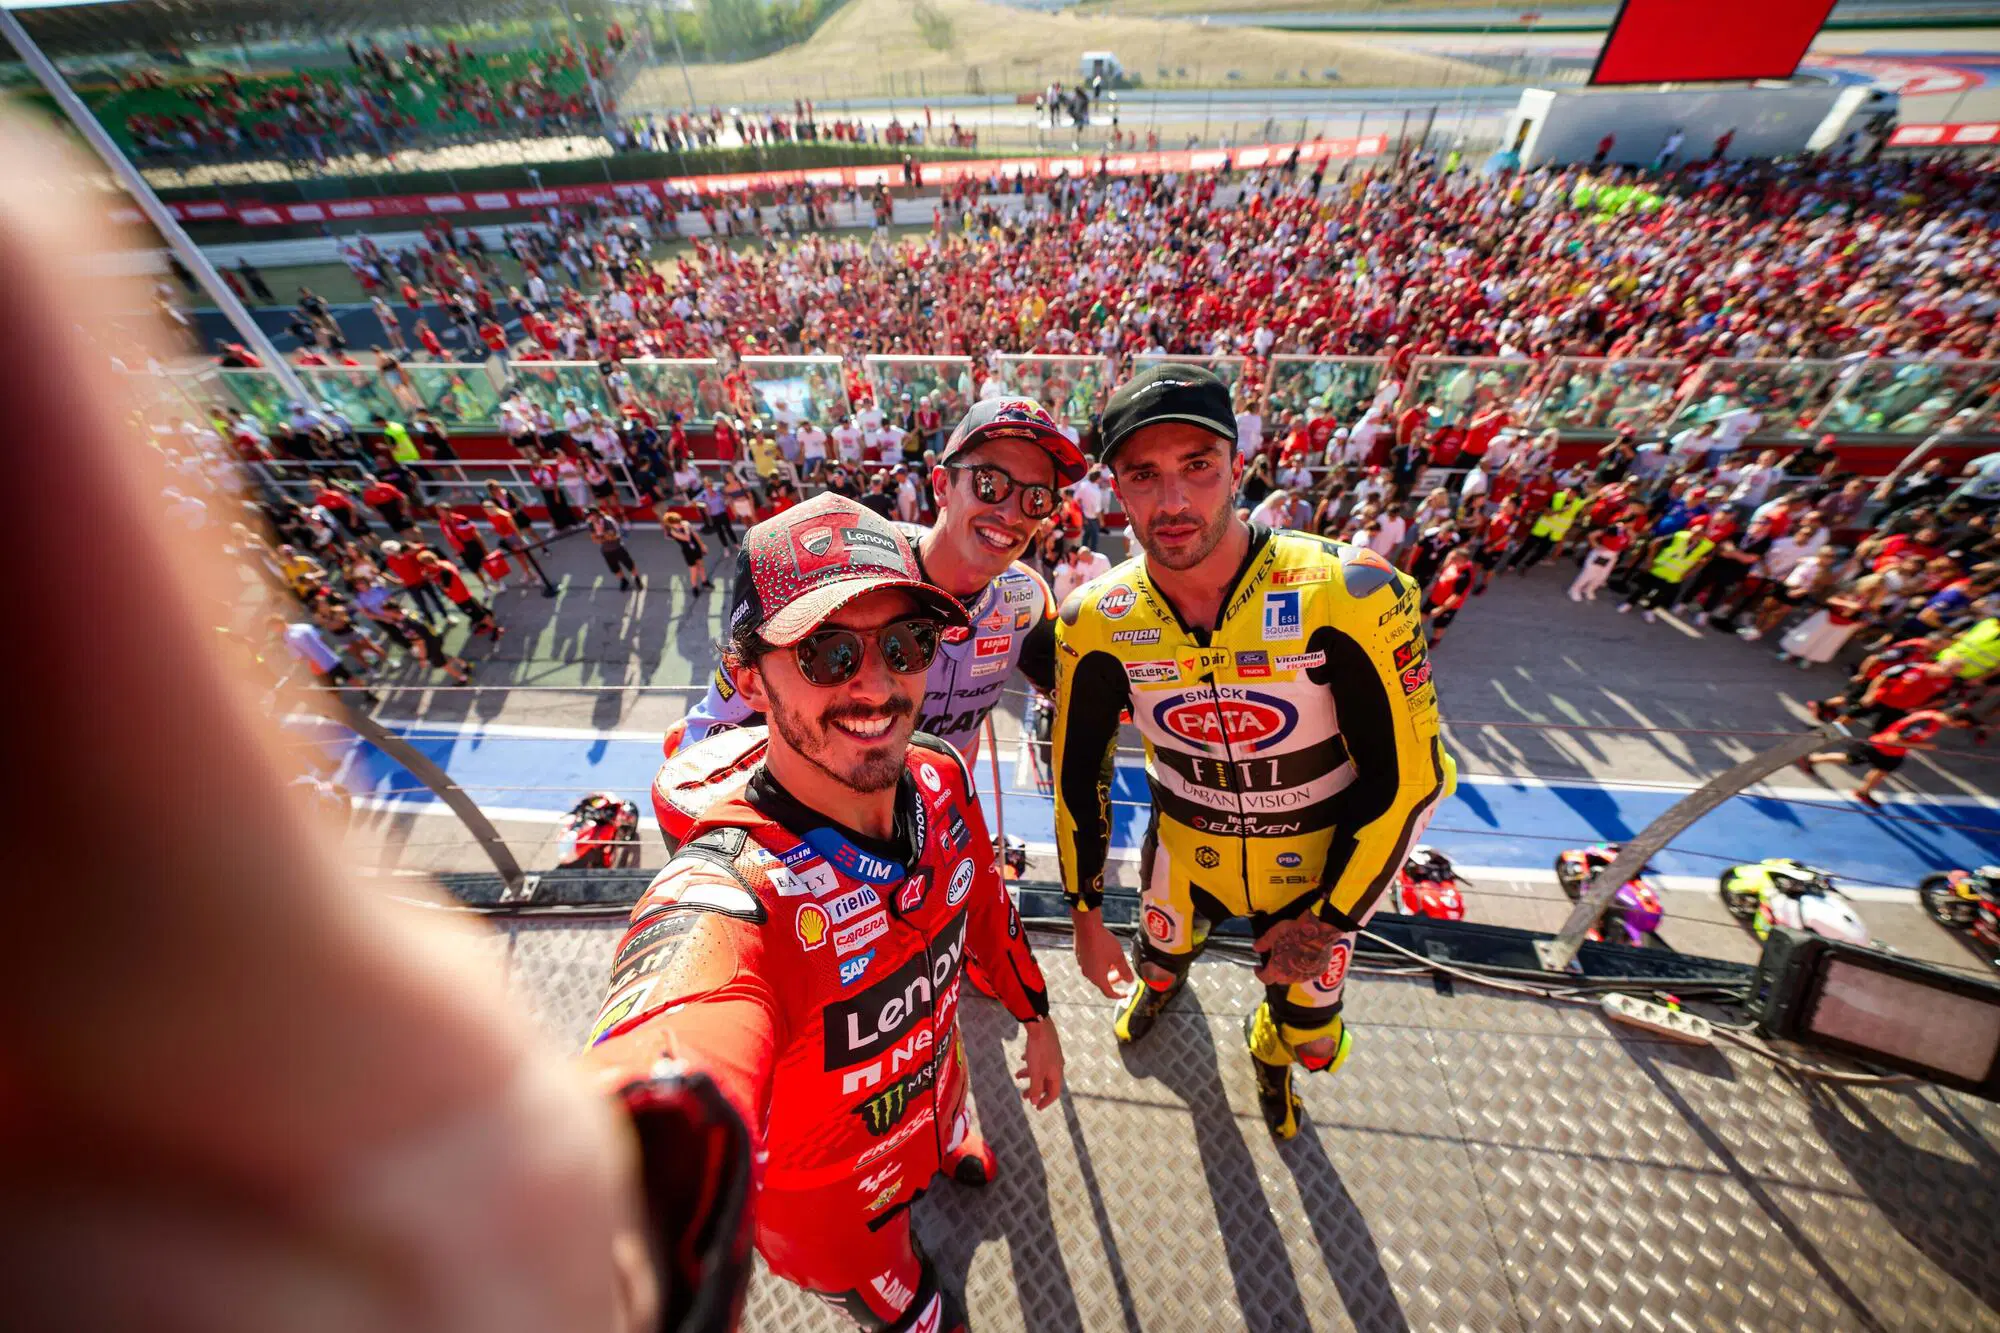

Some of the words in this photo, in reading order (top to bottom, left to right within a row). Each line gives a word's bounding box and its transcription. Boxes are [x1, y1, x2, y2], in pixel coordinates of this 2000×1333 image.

[846, 531, 895, 549] Lenovo
[1098, 593, 1137, 609] NILS
[1112, 629, 1161, 645] NOLAN
[1265, 626, 1299, 635] SQUARE
[1185, 688, 1244, 703] SNACK
[1178, 710, 1267, 735] PATA
[1182, 780, 1236, 808] URBAN
[1245, 787, 1311, 809] VISION
[1208, 822, 1301, 836] ELEVEN
[857, 854, 893, 880] TIM
[835, 888, 876, 917] riello
[836, 916, 887, 946] CARERA
[840, 957, 869, 984] SAP
[847, 908, 968, 1051] Lenov
